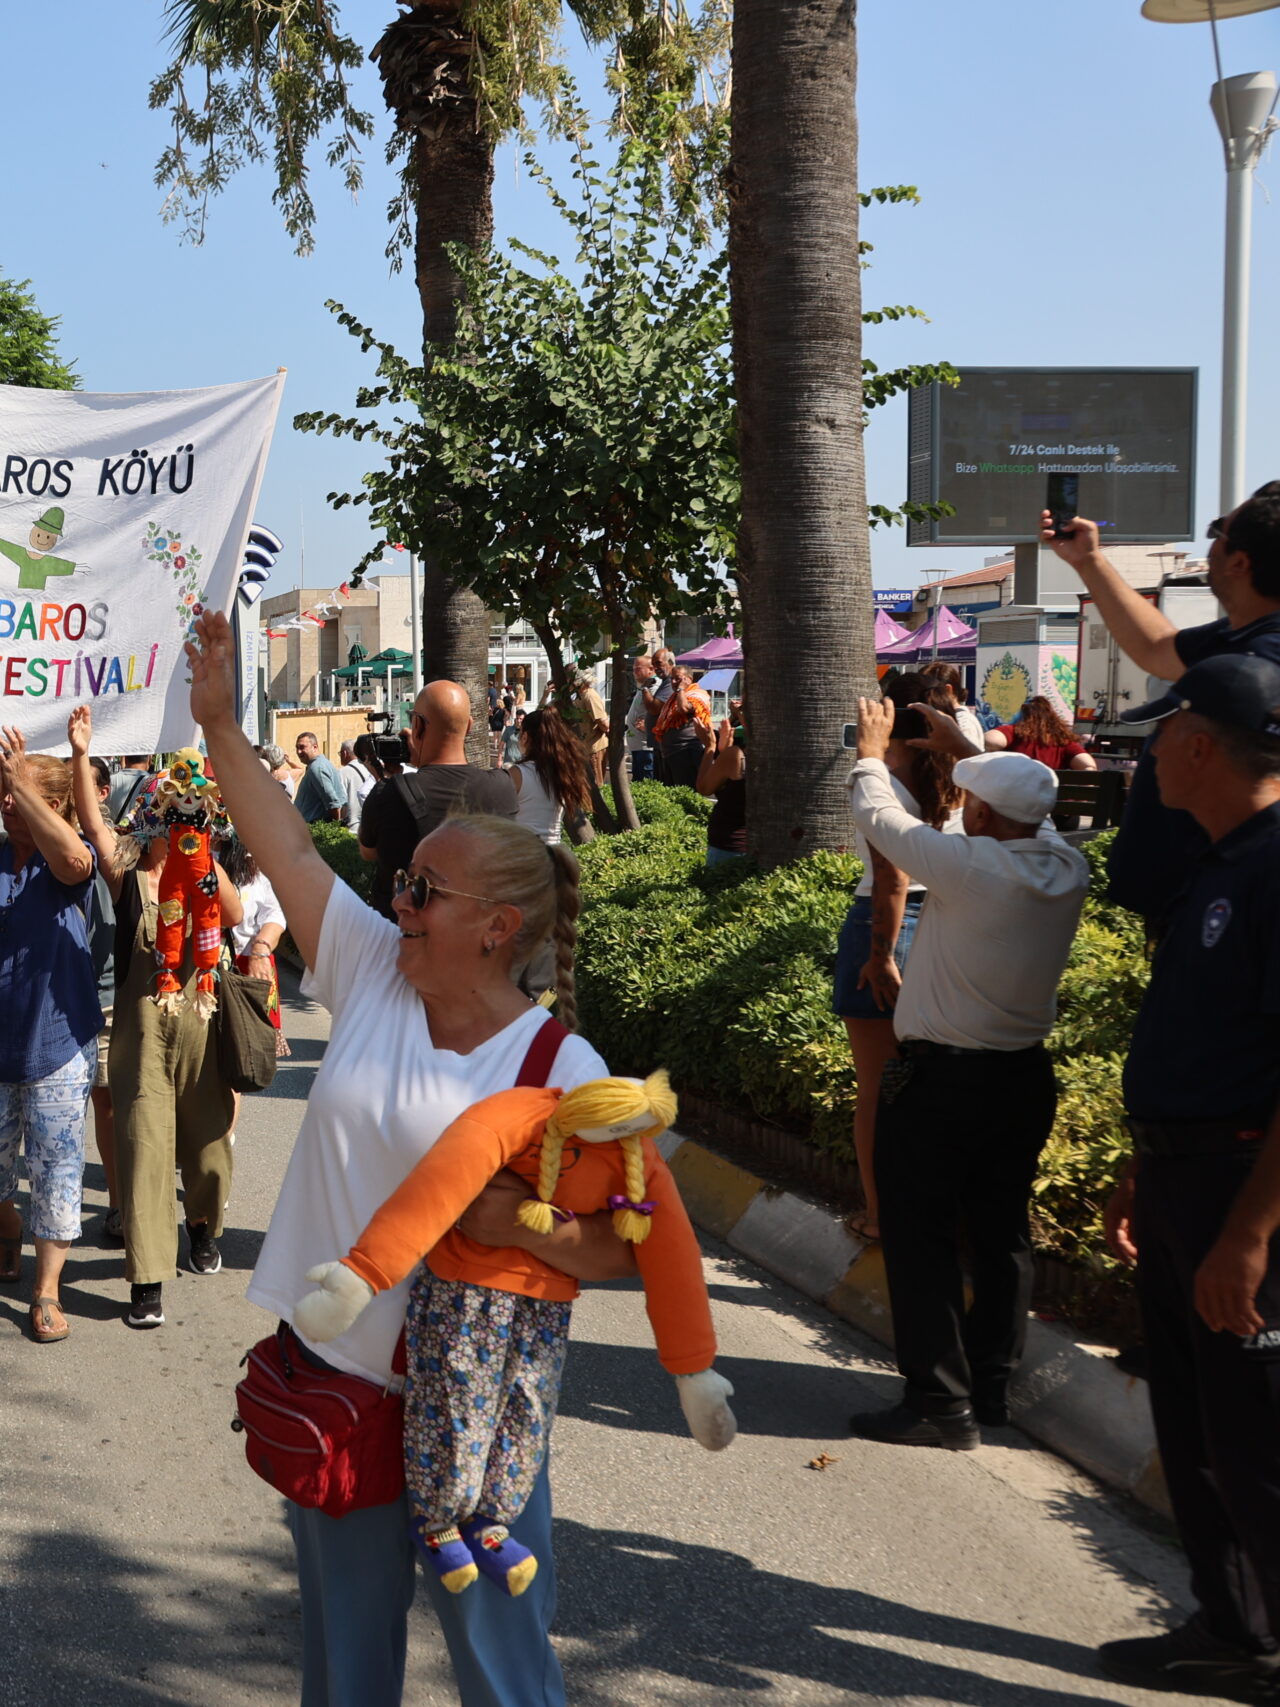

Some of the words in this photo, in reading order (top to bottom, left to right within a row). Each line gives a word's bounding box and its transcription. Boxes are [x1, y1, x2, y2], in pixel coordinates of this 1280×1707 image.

[1009, 444, 1035, 455] 7/24
[1036, 444, 1066, 455] Canlı
[1067, 444, 1105, 455] Destek
[1106, 444, 1120, 455] ile
[98, 443, 194, 496] KÖYÜ
[955, 462, 978, 473] Bize
[980, 462, 1035, 474] Whatsapp
[1037, 462, 1103, 473] Hattımızdan
[877, 593, 912, 601] BANKER
[246, 631, 256, 662] İZMİR
